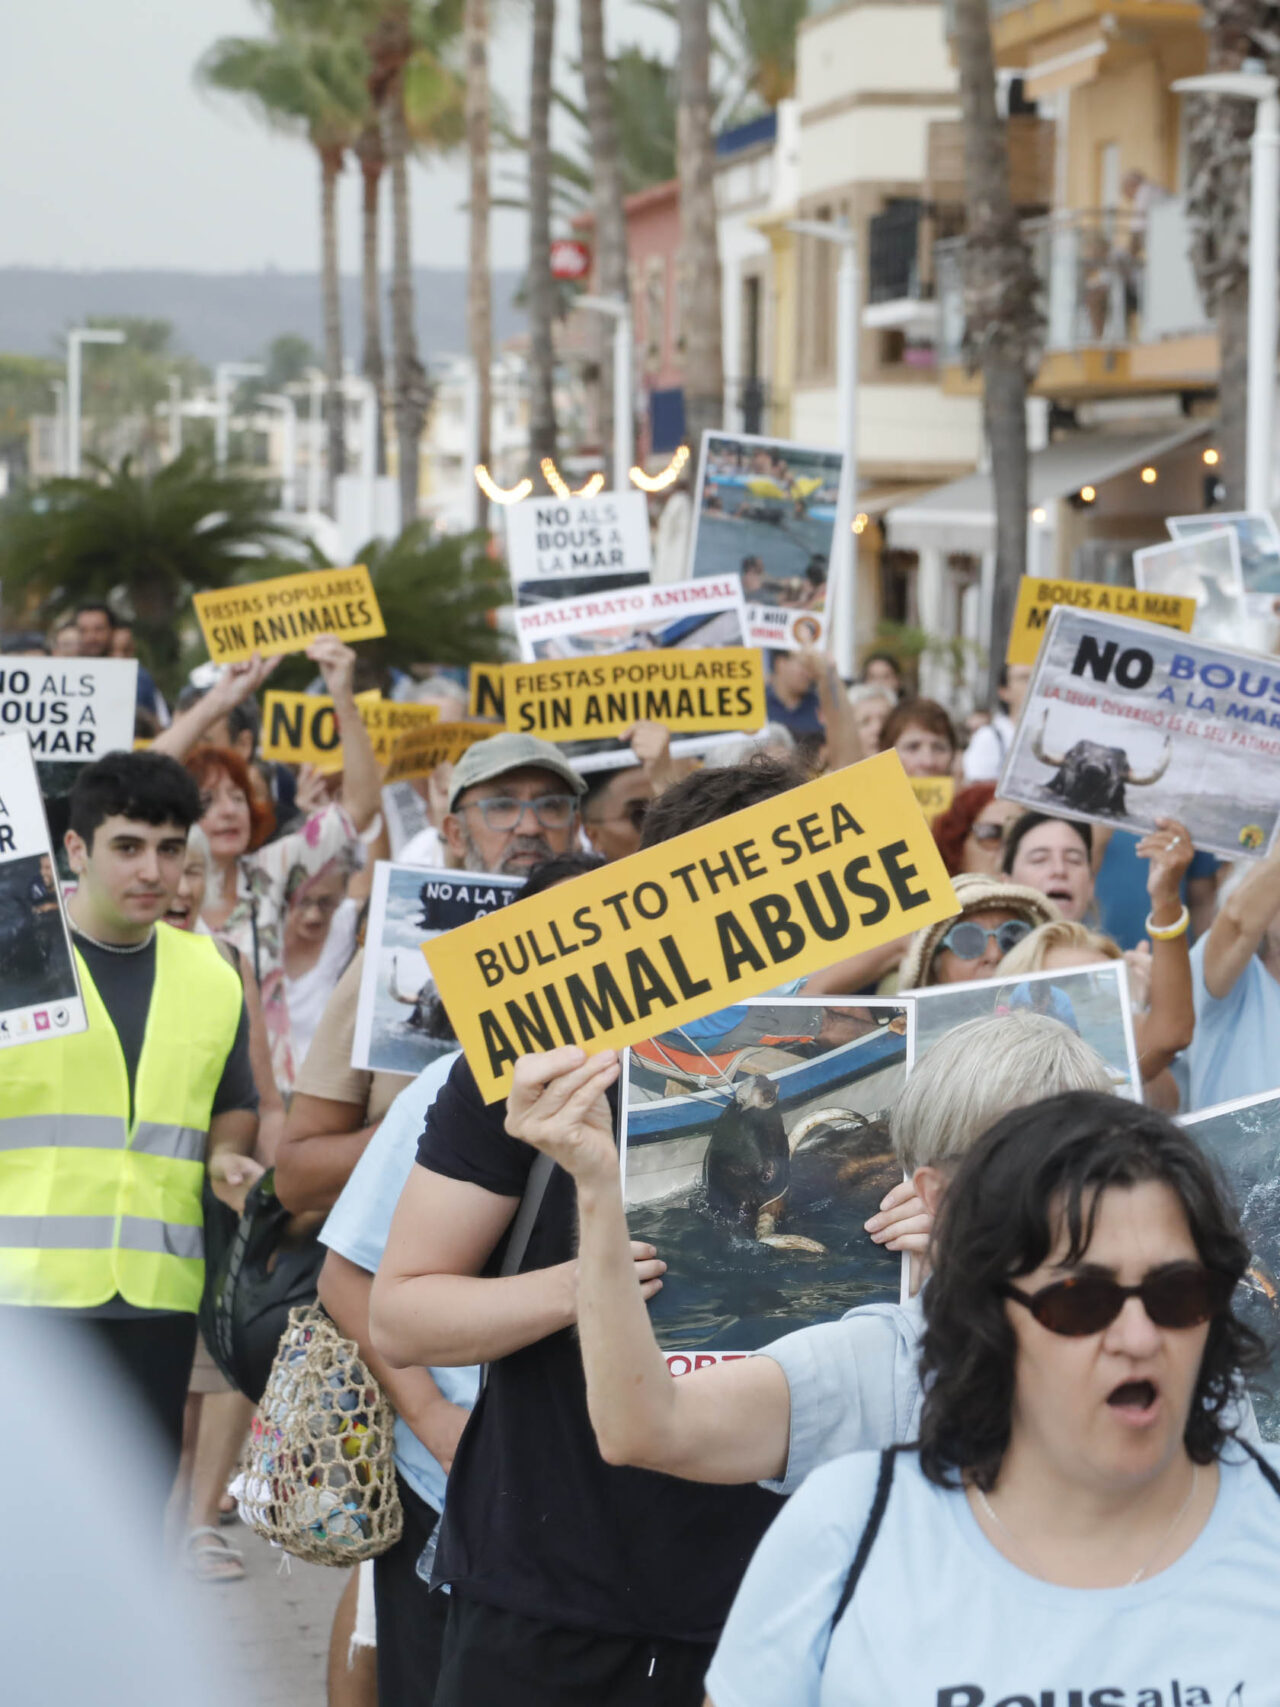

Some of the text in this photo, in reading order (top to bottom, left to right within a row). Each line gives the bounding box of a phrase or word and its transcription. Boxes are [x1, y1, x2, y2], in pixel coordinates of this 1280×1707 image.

[536, 504, 617, 527] NO ALS
[536, 529, 623, 550] BOUS A
[537, 549, 624, 573] LA MAR
[203, 578, 367, 620] FIESTAS POPULARES
[520, 581, 738, 630] MALTRATO ANIMAL
[1037, 582, 1182, 617] BOUS A LA MAR
[212, 600, 373, 654] SIN ANIMALES
[514, 660, 753, 695] FIESTAS POPULARES
[1070, 634, 1155, 690] NO
[0, 669, 96, 697] O ALS
[1156, 685, 1176, 704] A
[1185, 692, 1216, 715] LA
[78, 705, 96, 725] A
[519, 686, 753, 733] SIN ANIMALES
[1043, 686, 1061, 700] LA
[1101, 698, 1165, 727] DIVERSIÓ
[1185, 721, 1199, 737] EL
[1202, 724, 1226, 744] SEU
[426, 882, 453, 901] NO
[455, 885, 470, 903] A
[474, 888, 497, 906] LA
[474, 801, 866, 988] BULLS TO THE SEA
[477, 838, 932, 1080] ANIMAL ABUSE
